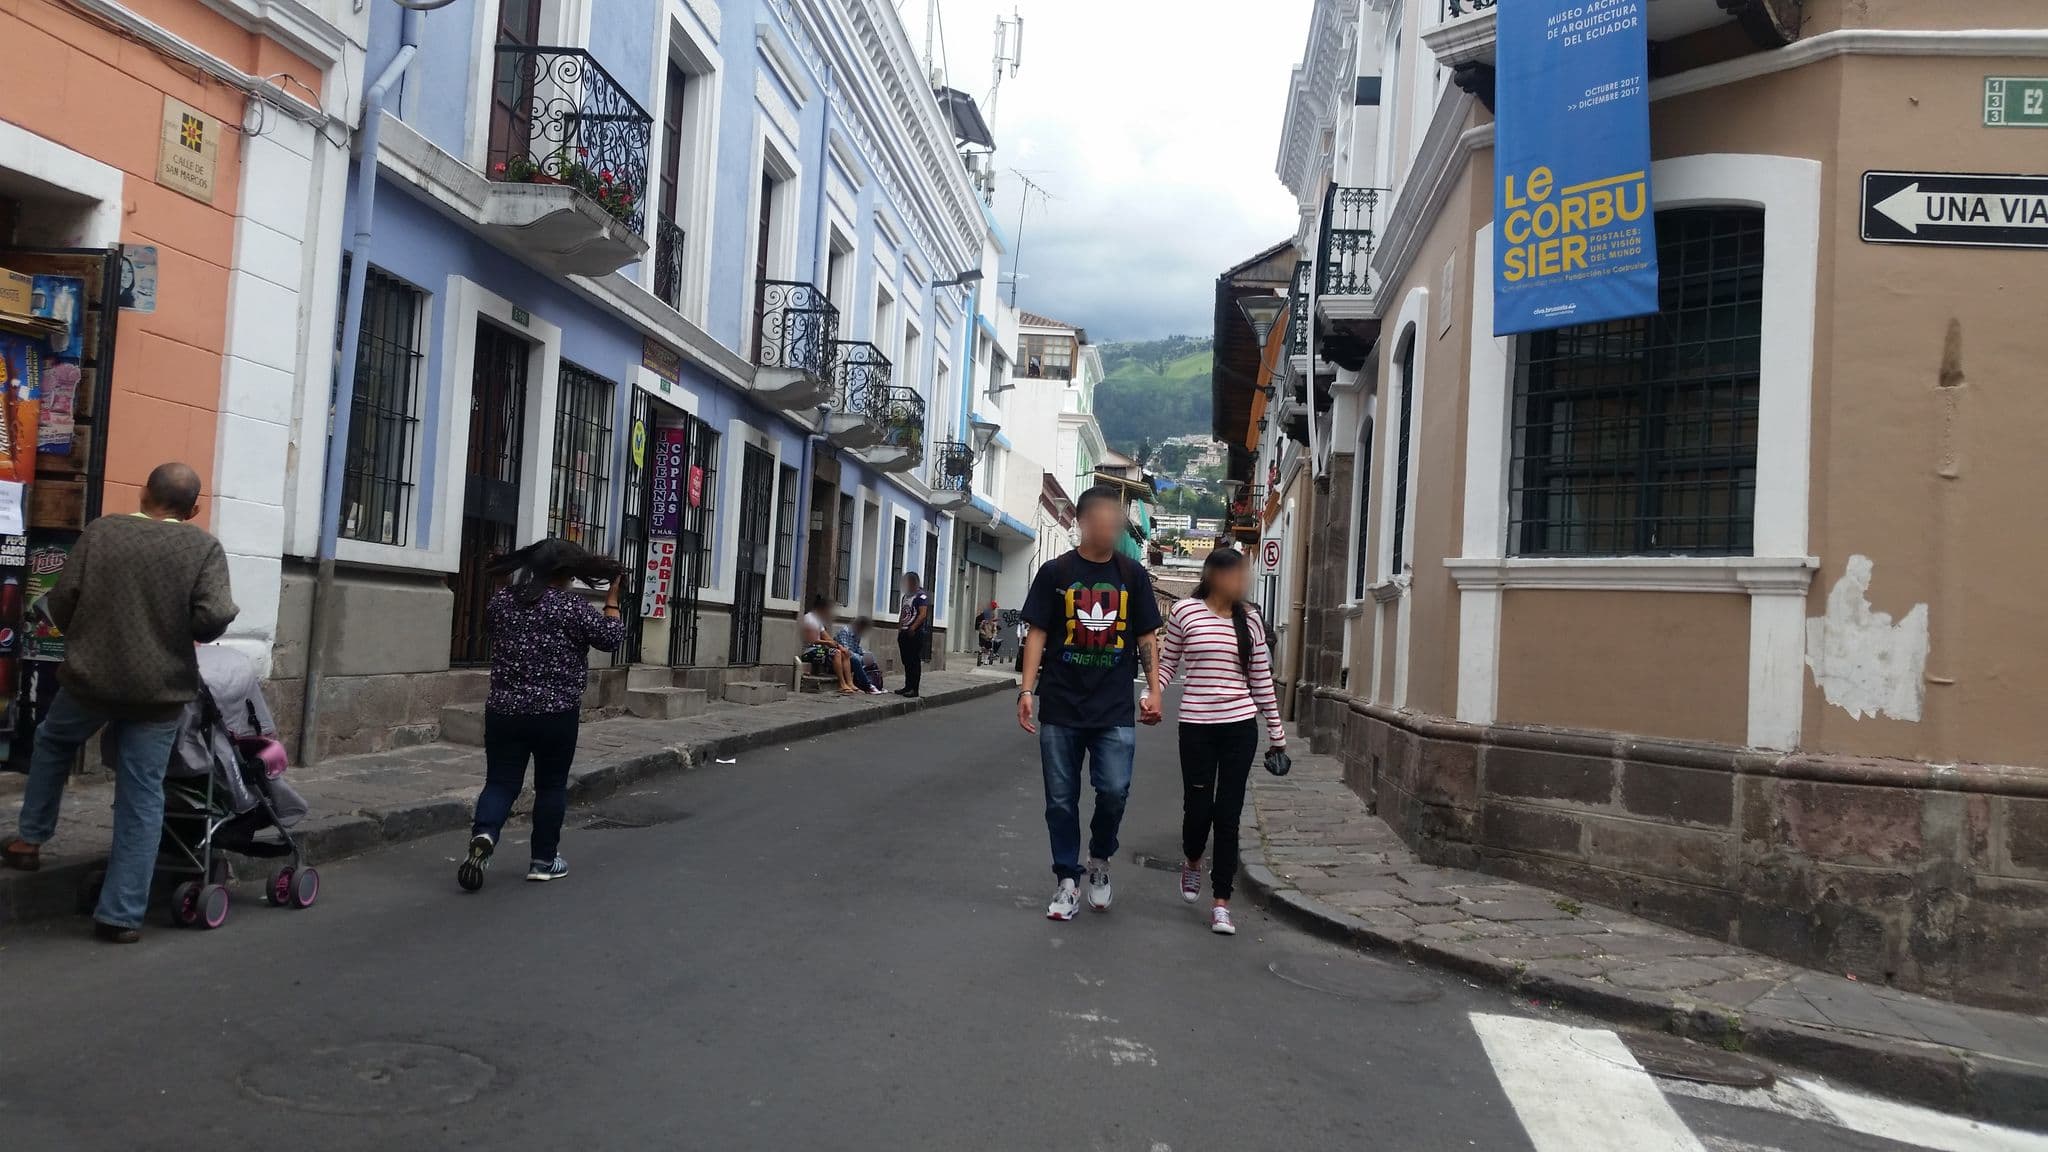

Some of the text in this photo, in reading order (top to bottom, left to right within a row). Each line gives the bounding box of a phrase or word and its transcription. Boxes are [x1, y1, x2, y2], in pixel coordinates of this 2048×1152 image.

[1547, 7, 1583, 27] MUSEO
[1547, 3, 1638, 40] DE ARQUITECTURA
[1564, 17, 1638, 47] DEL ECUADOR
[1579, 91, 1619, 110] DICIEMBRE
[1620, 86, 1640, 98] 2017
[1585, 76, 1640, 97] OCTUBRE 2017
[2023, 88, 2044, 115] E2
[166, 164, 207, 190] SAN MARCOS
[173, 154, 204, 175] CALLE DE
[1504, 182, 1646, 244] CORBU
[1926, 196, 2048, 223] UNA VIA
[1590, 228, 1641, 243] POSTALES:
[1503, 234, 1588, 282] SIER
[1590, 244, 1608, 253] UNA
[1590, 247, 1641, 262] DEL MUNDO
[652, 431, 669, 526] INTERNET
[667, 443, 681, 514] COPIAS
[1, 545, 26, 556] SABOR
[6, 536, 27, 546] PEPSI
